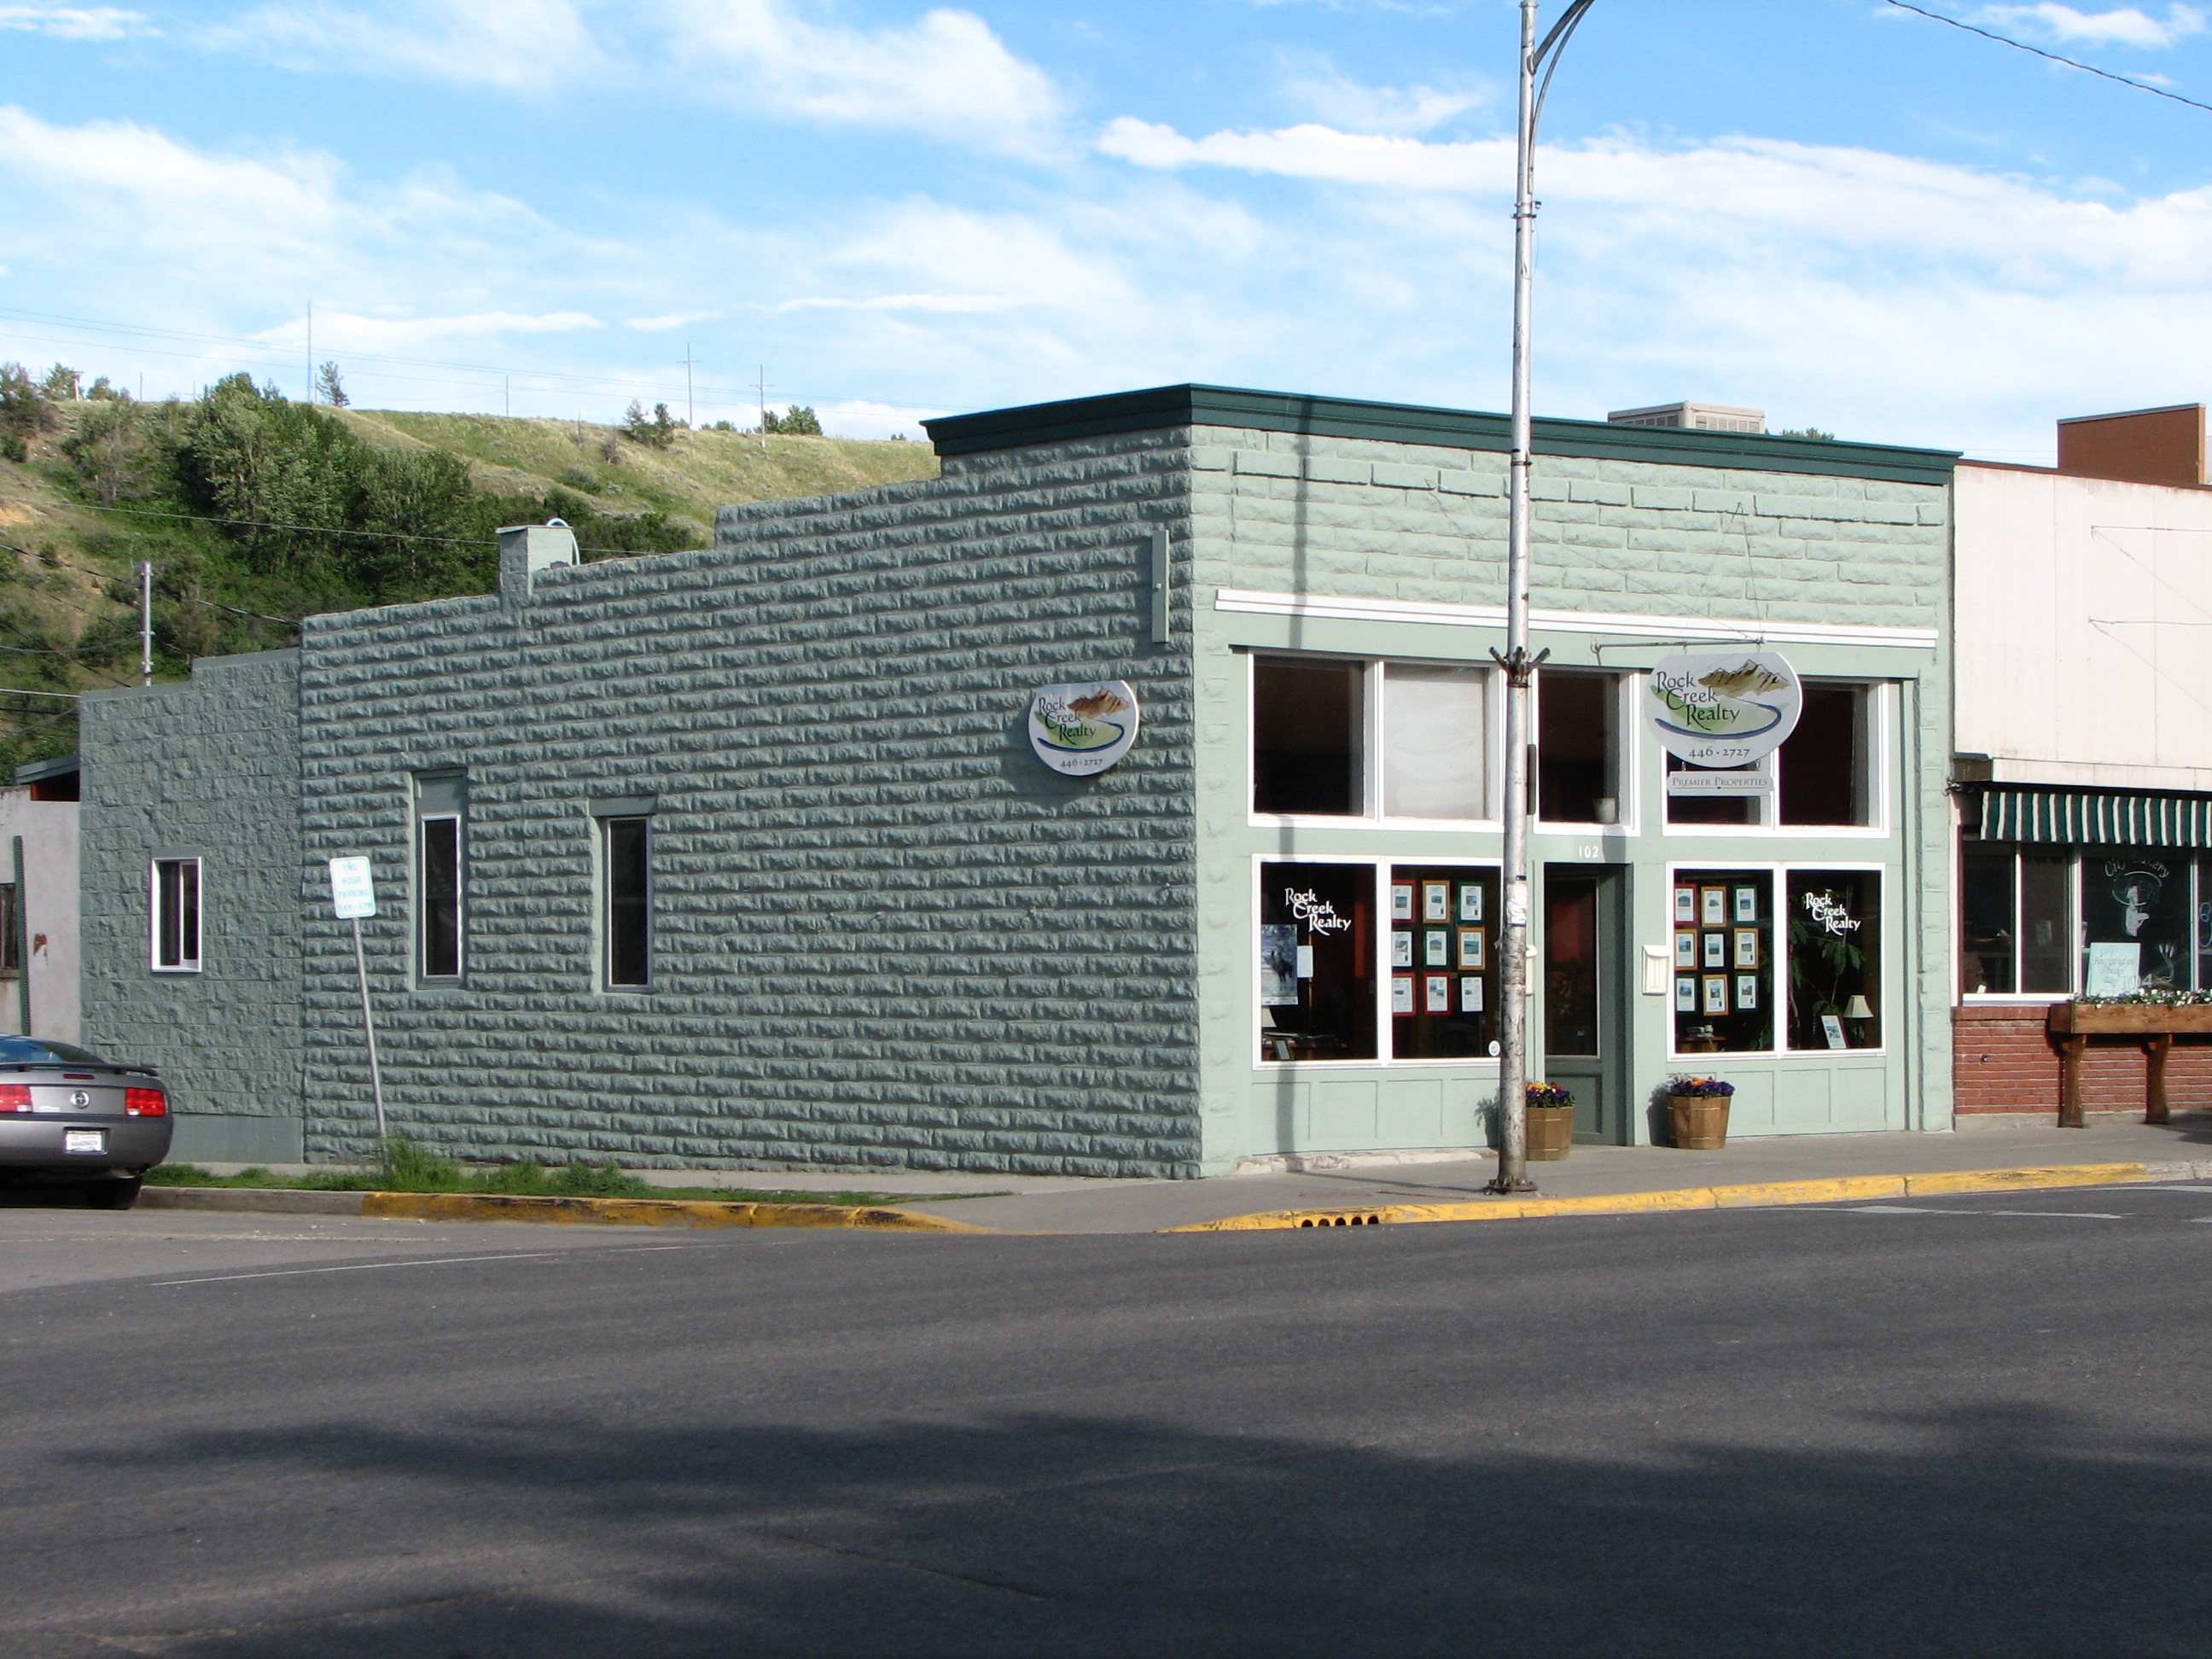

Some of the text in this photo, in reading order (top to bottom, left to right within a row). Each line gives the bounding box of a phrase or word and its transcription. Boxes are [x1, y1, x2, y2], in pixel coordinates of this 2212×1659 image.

[1656, 671, 1696, 694] Rock
[1039, 697, 1066, 715] Rock
[1666, 686, 1719, 711] Creek
[1045, 709, 1081, 729] Creek
[1685, 703, 1741, 731] Realty
[1060, 724, 1097, 746] Realty
[1672, 777, 1767, 787] PREMIER PROPERTIES
[1579, 845, 1599, 859] 102
[1284, 888, 1317, 907] Rock
[1805, 891, 1833, 911] Rock
[1293, 900, 1335, 919] Creek
[1812, 905, 1847, 921] Creek
[1308, 914, 1352, 936] Realty
[1825, 916, 1861, 936] Realty
